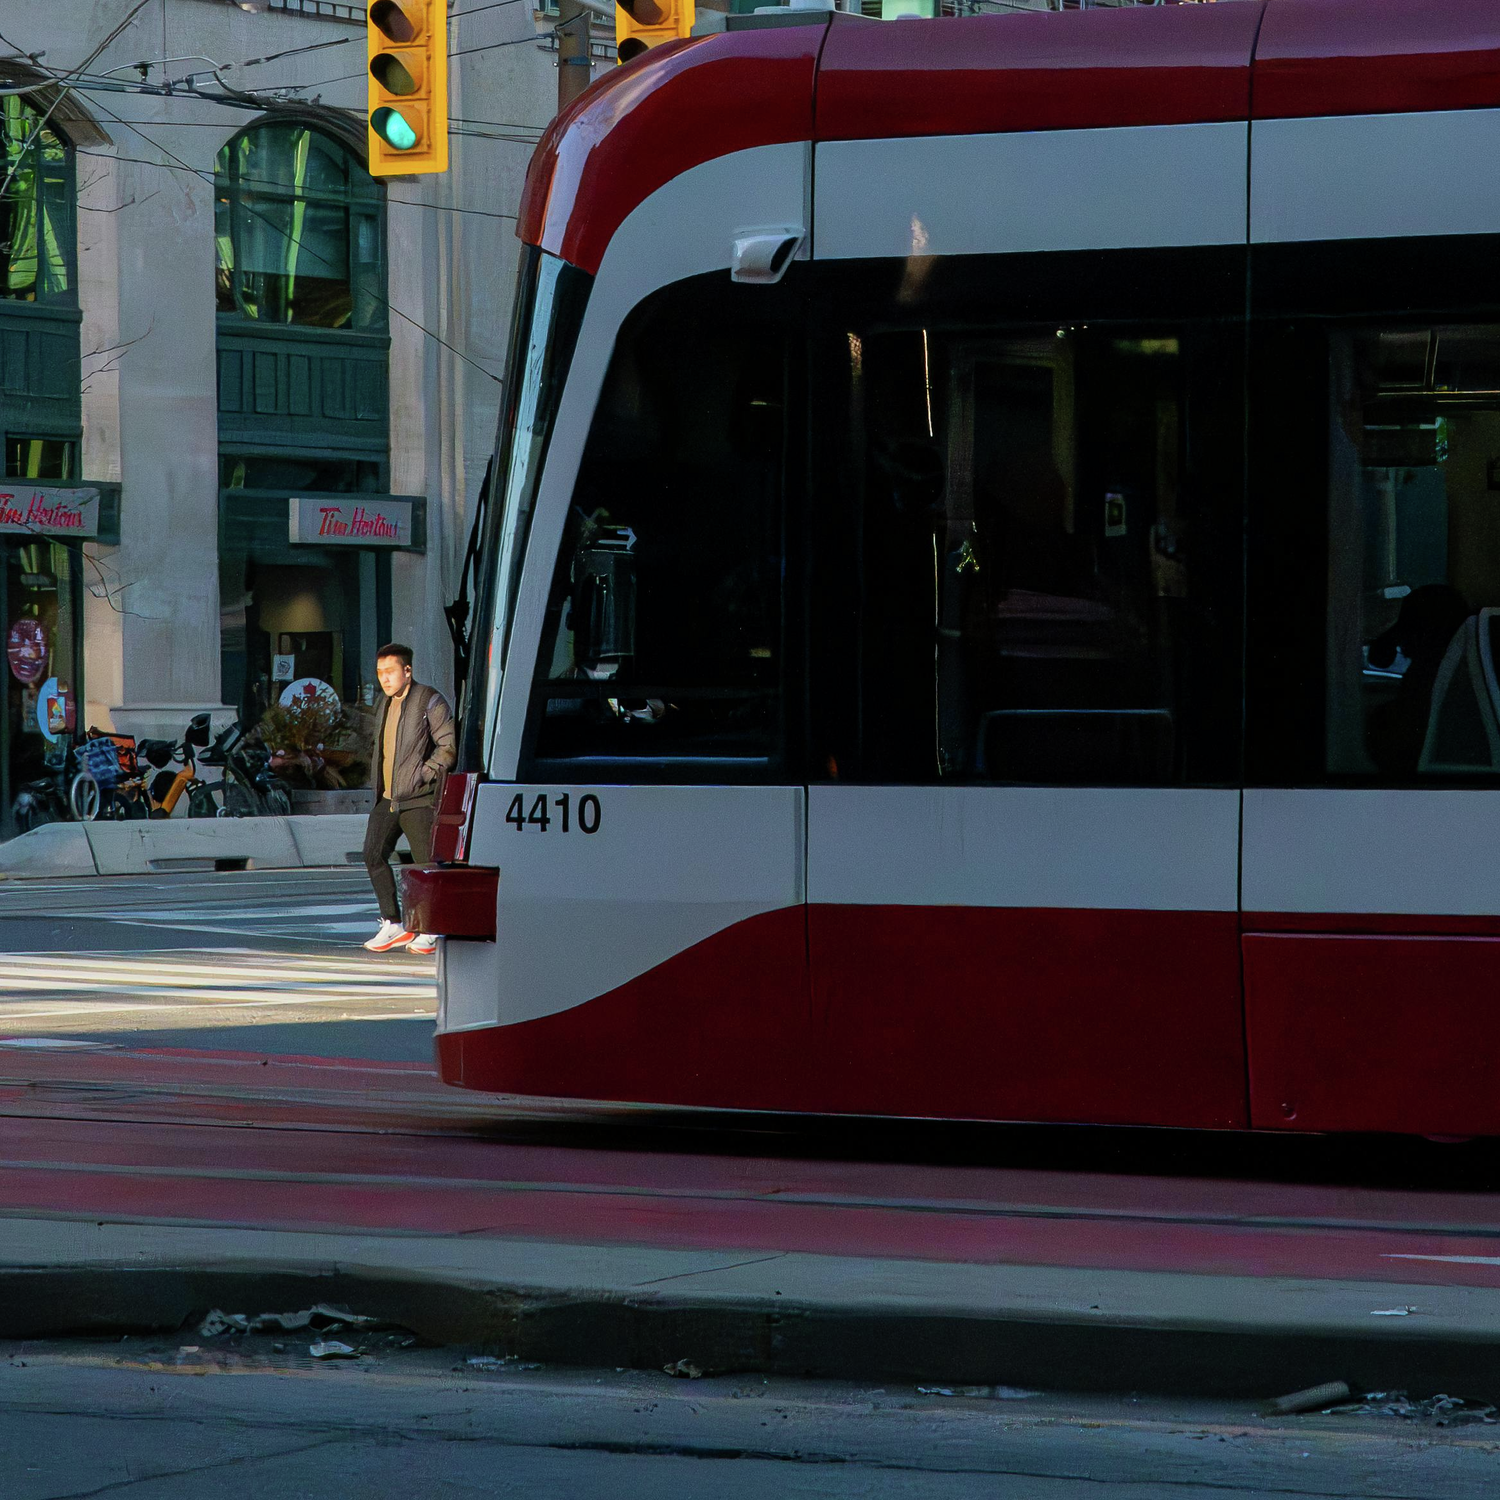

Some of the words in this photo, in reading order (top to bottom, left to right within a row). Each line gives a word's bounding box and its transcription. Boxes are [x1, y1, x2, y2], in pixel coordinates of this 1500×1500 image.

[24, 490, 84, 528] Hortons
[319, 507, 348, 535] Tim
[349, 507, 399, 537] Hortons
[505, 791, 602, 835] 4410
